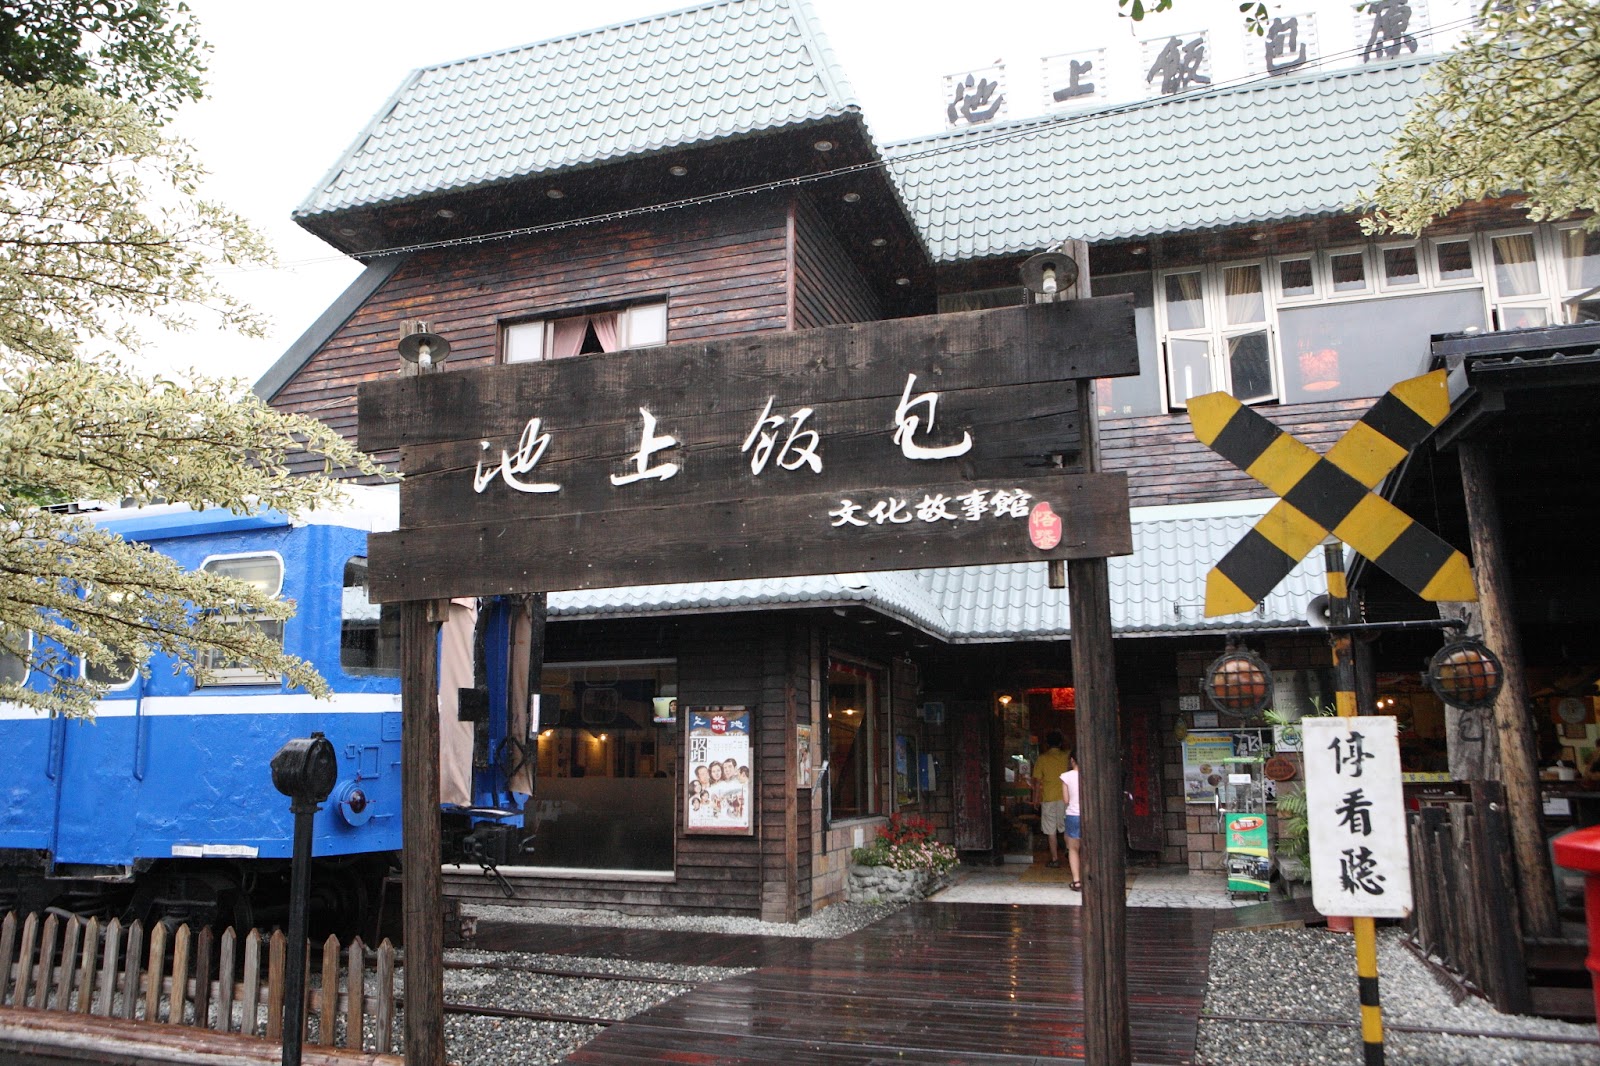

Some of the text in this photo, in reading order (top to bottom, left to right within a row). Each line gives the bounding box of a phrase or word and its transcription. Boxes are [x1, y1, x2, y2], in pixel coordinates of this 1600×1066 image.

[474, 374, 973, 493] 池上飯包
[829, 489, 1032, 527] 文化故事館
[1328, 732, 1385, 895] 停看聽
